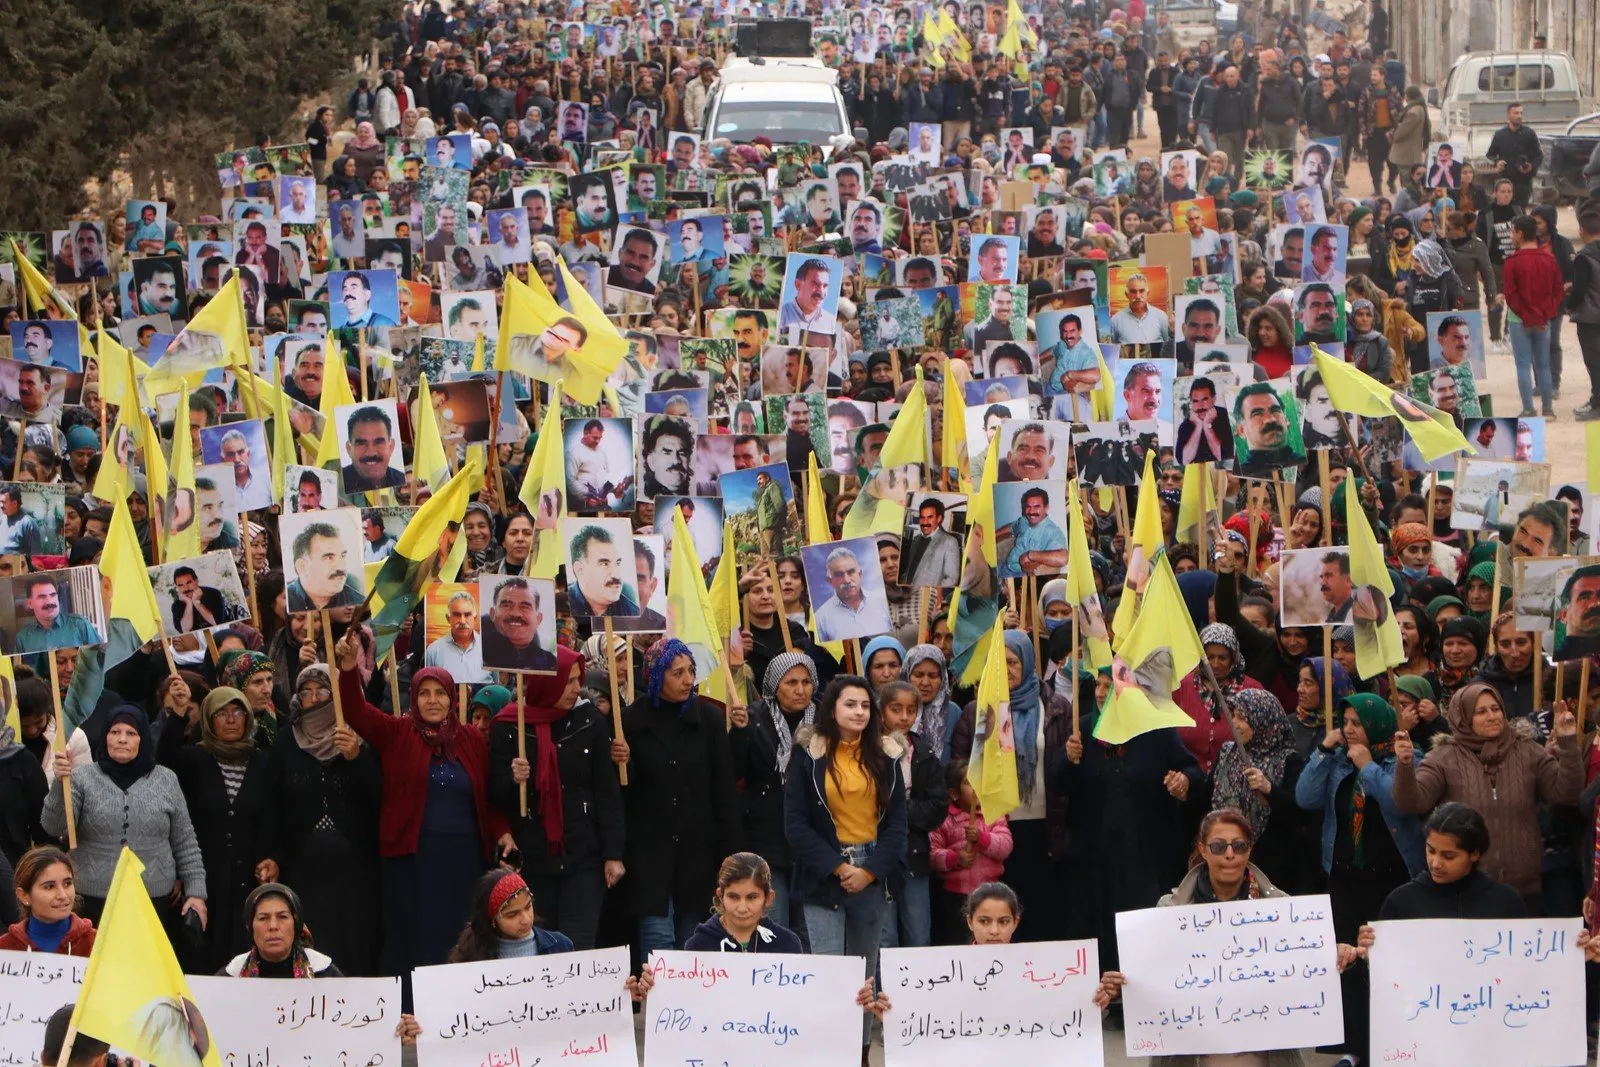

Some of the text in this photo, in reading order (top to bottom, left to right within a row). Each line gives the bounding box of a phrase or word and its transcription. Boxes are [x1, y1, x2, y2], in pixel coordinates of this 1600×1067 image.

[1179, 903, 1324, 932] عندما نعشق الحياة
[1222, 936, 1267, 960] الوطن
[1275, 935, 1324, 952] نعشق
[1464, 928, 1565, 964] المرأة الحرة
[37, 966, 63, 984] قوة
[541, 963, 580, 988] الحرية
[652, 957, 729, 989] Azadiya
[900, 947, 1087, 991] الحرية هي العودة
[1175, 964, 1327, 989] ومن لا يعشق الوطن
[277, 995, 385, 1030] ثورة المرأة
[440, 996, 621, 1039] العلاقة بين الجنسين إلى
[1159, 1006, 1204, 1030] بالحياة
[1278, 992, 1325, 1016] ليس
[1503, 990, 1550, 1028] تصنع
[722, 1011, 799, 1045] azadiya
[901, 1008, 1082, 1046] إلى جذور ثقافة المرأة
